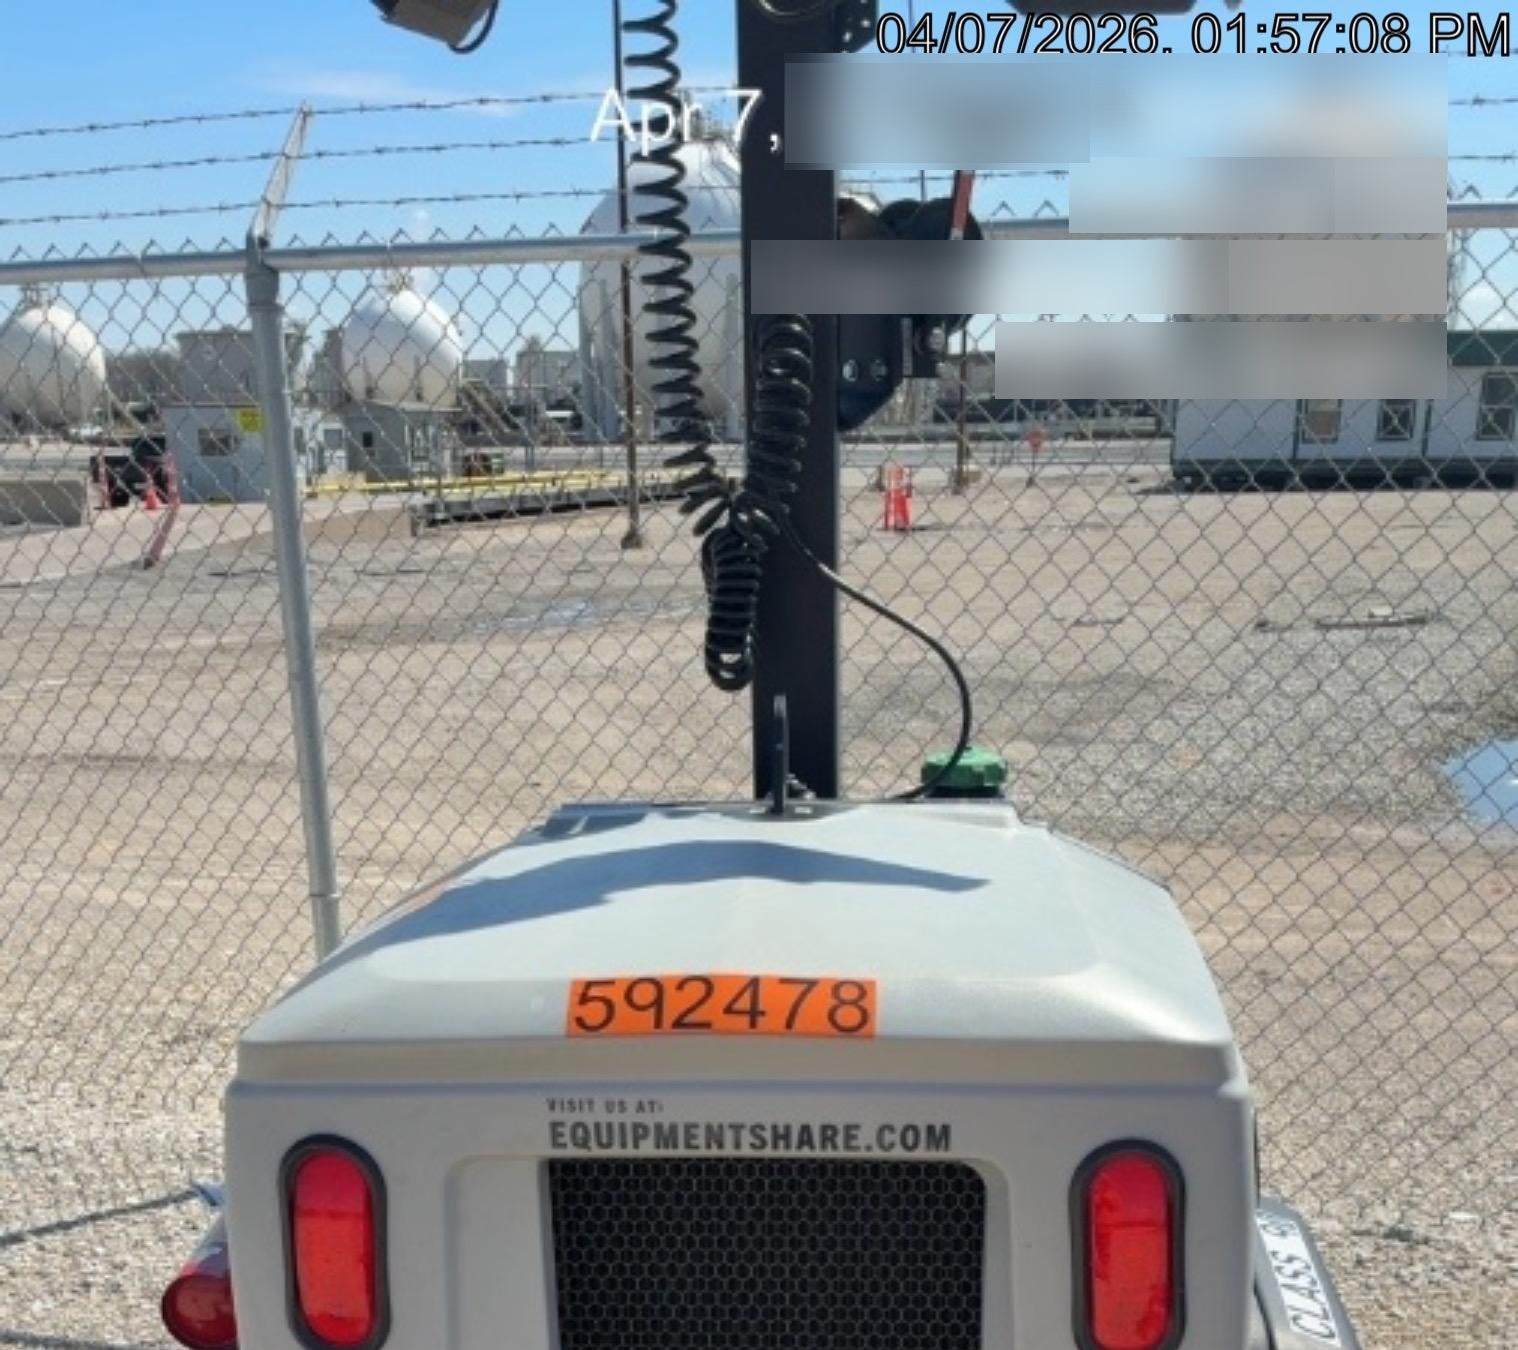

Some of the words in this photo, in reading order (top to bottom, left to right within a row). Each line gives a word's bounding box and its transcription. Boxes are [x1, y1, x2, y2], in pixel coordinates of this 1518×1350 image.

[574, 975, 870, 1033] 592478
[546, 1098, 595, 1114] VISIT
[605, 1100, 628, 1114] US
[549, 1120, 953, 1152] EQUIPMENTSHARE.COM
[1269, 1249, 1337, 1340] CLASS
